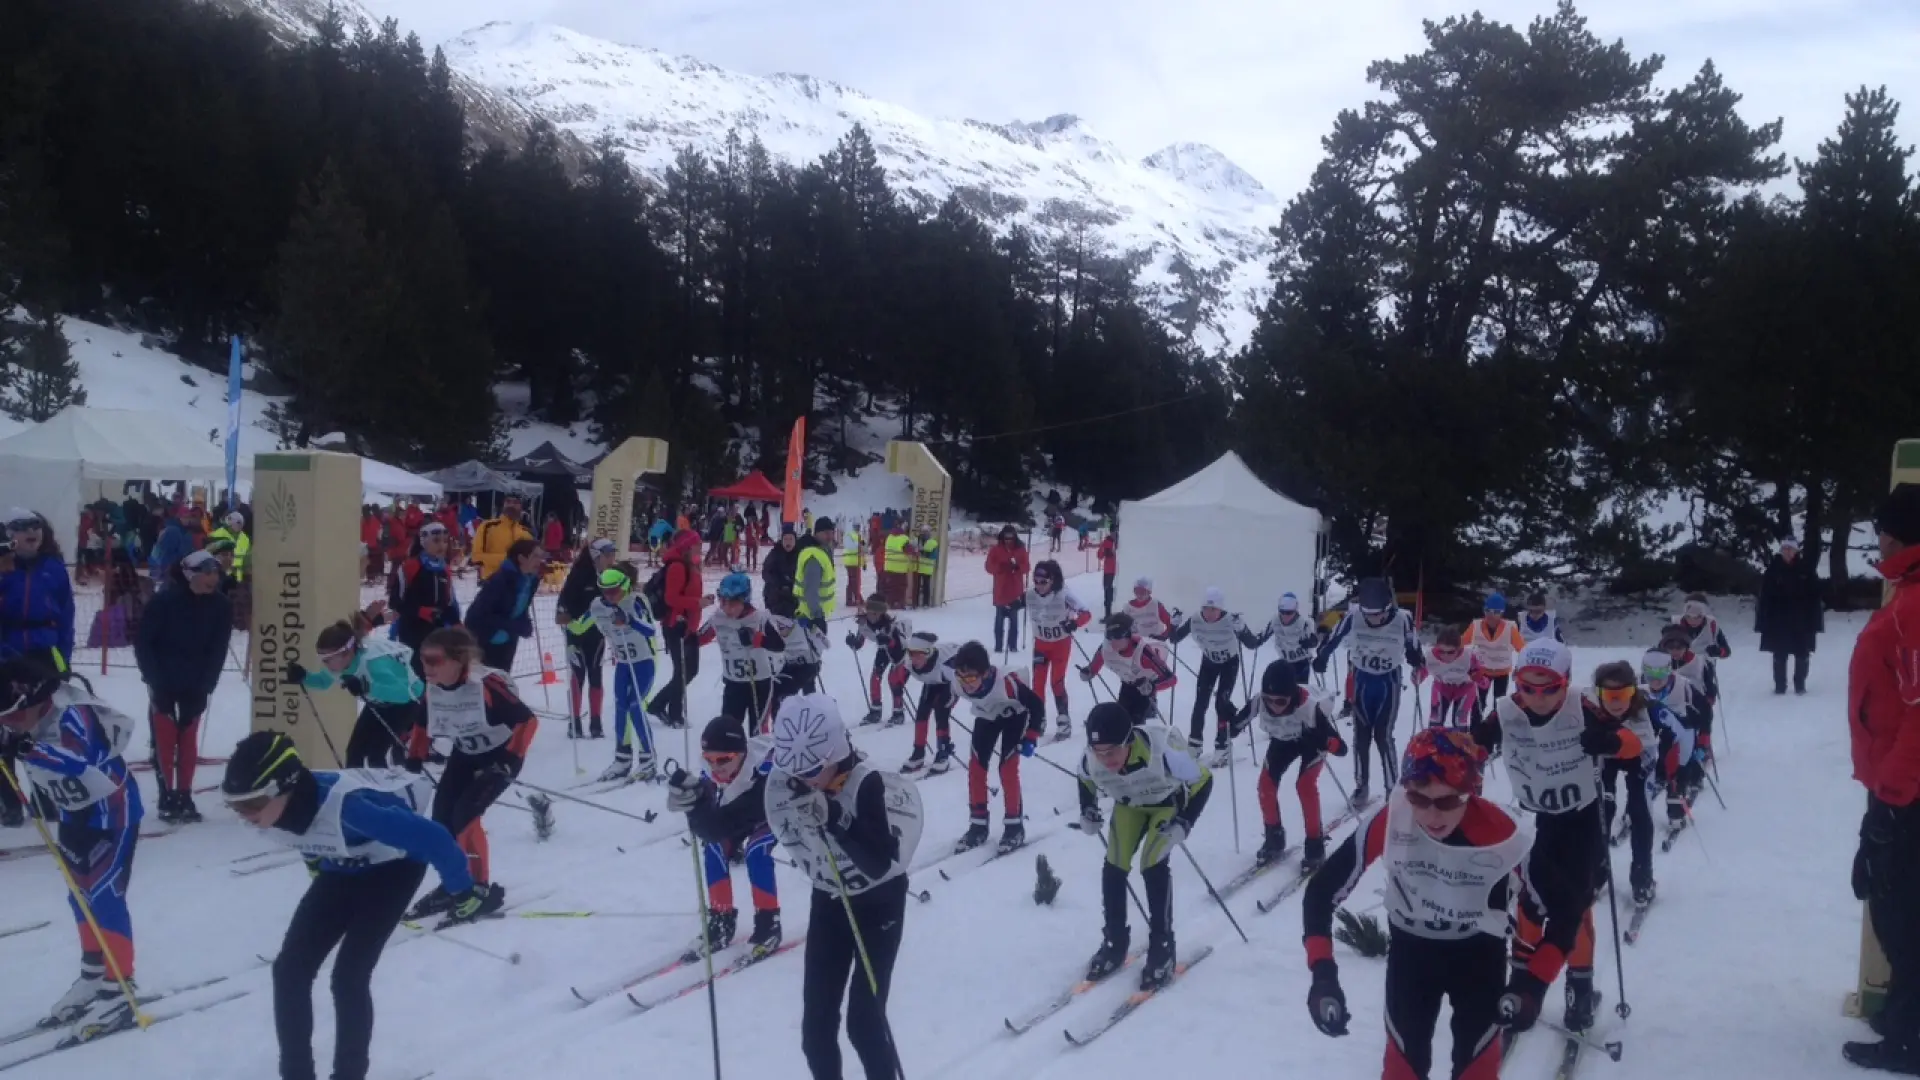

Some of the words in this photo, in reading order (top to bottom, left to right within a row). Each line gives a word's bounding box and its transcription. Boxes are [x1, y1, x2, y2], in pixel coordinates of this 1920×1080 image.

[255, 622, 277, 720] Llanos
[1361, 655, 1393, 672] 145
[281, 686, 300, 726] del
